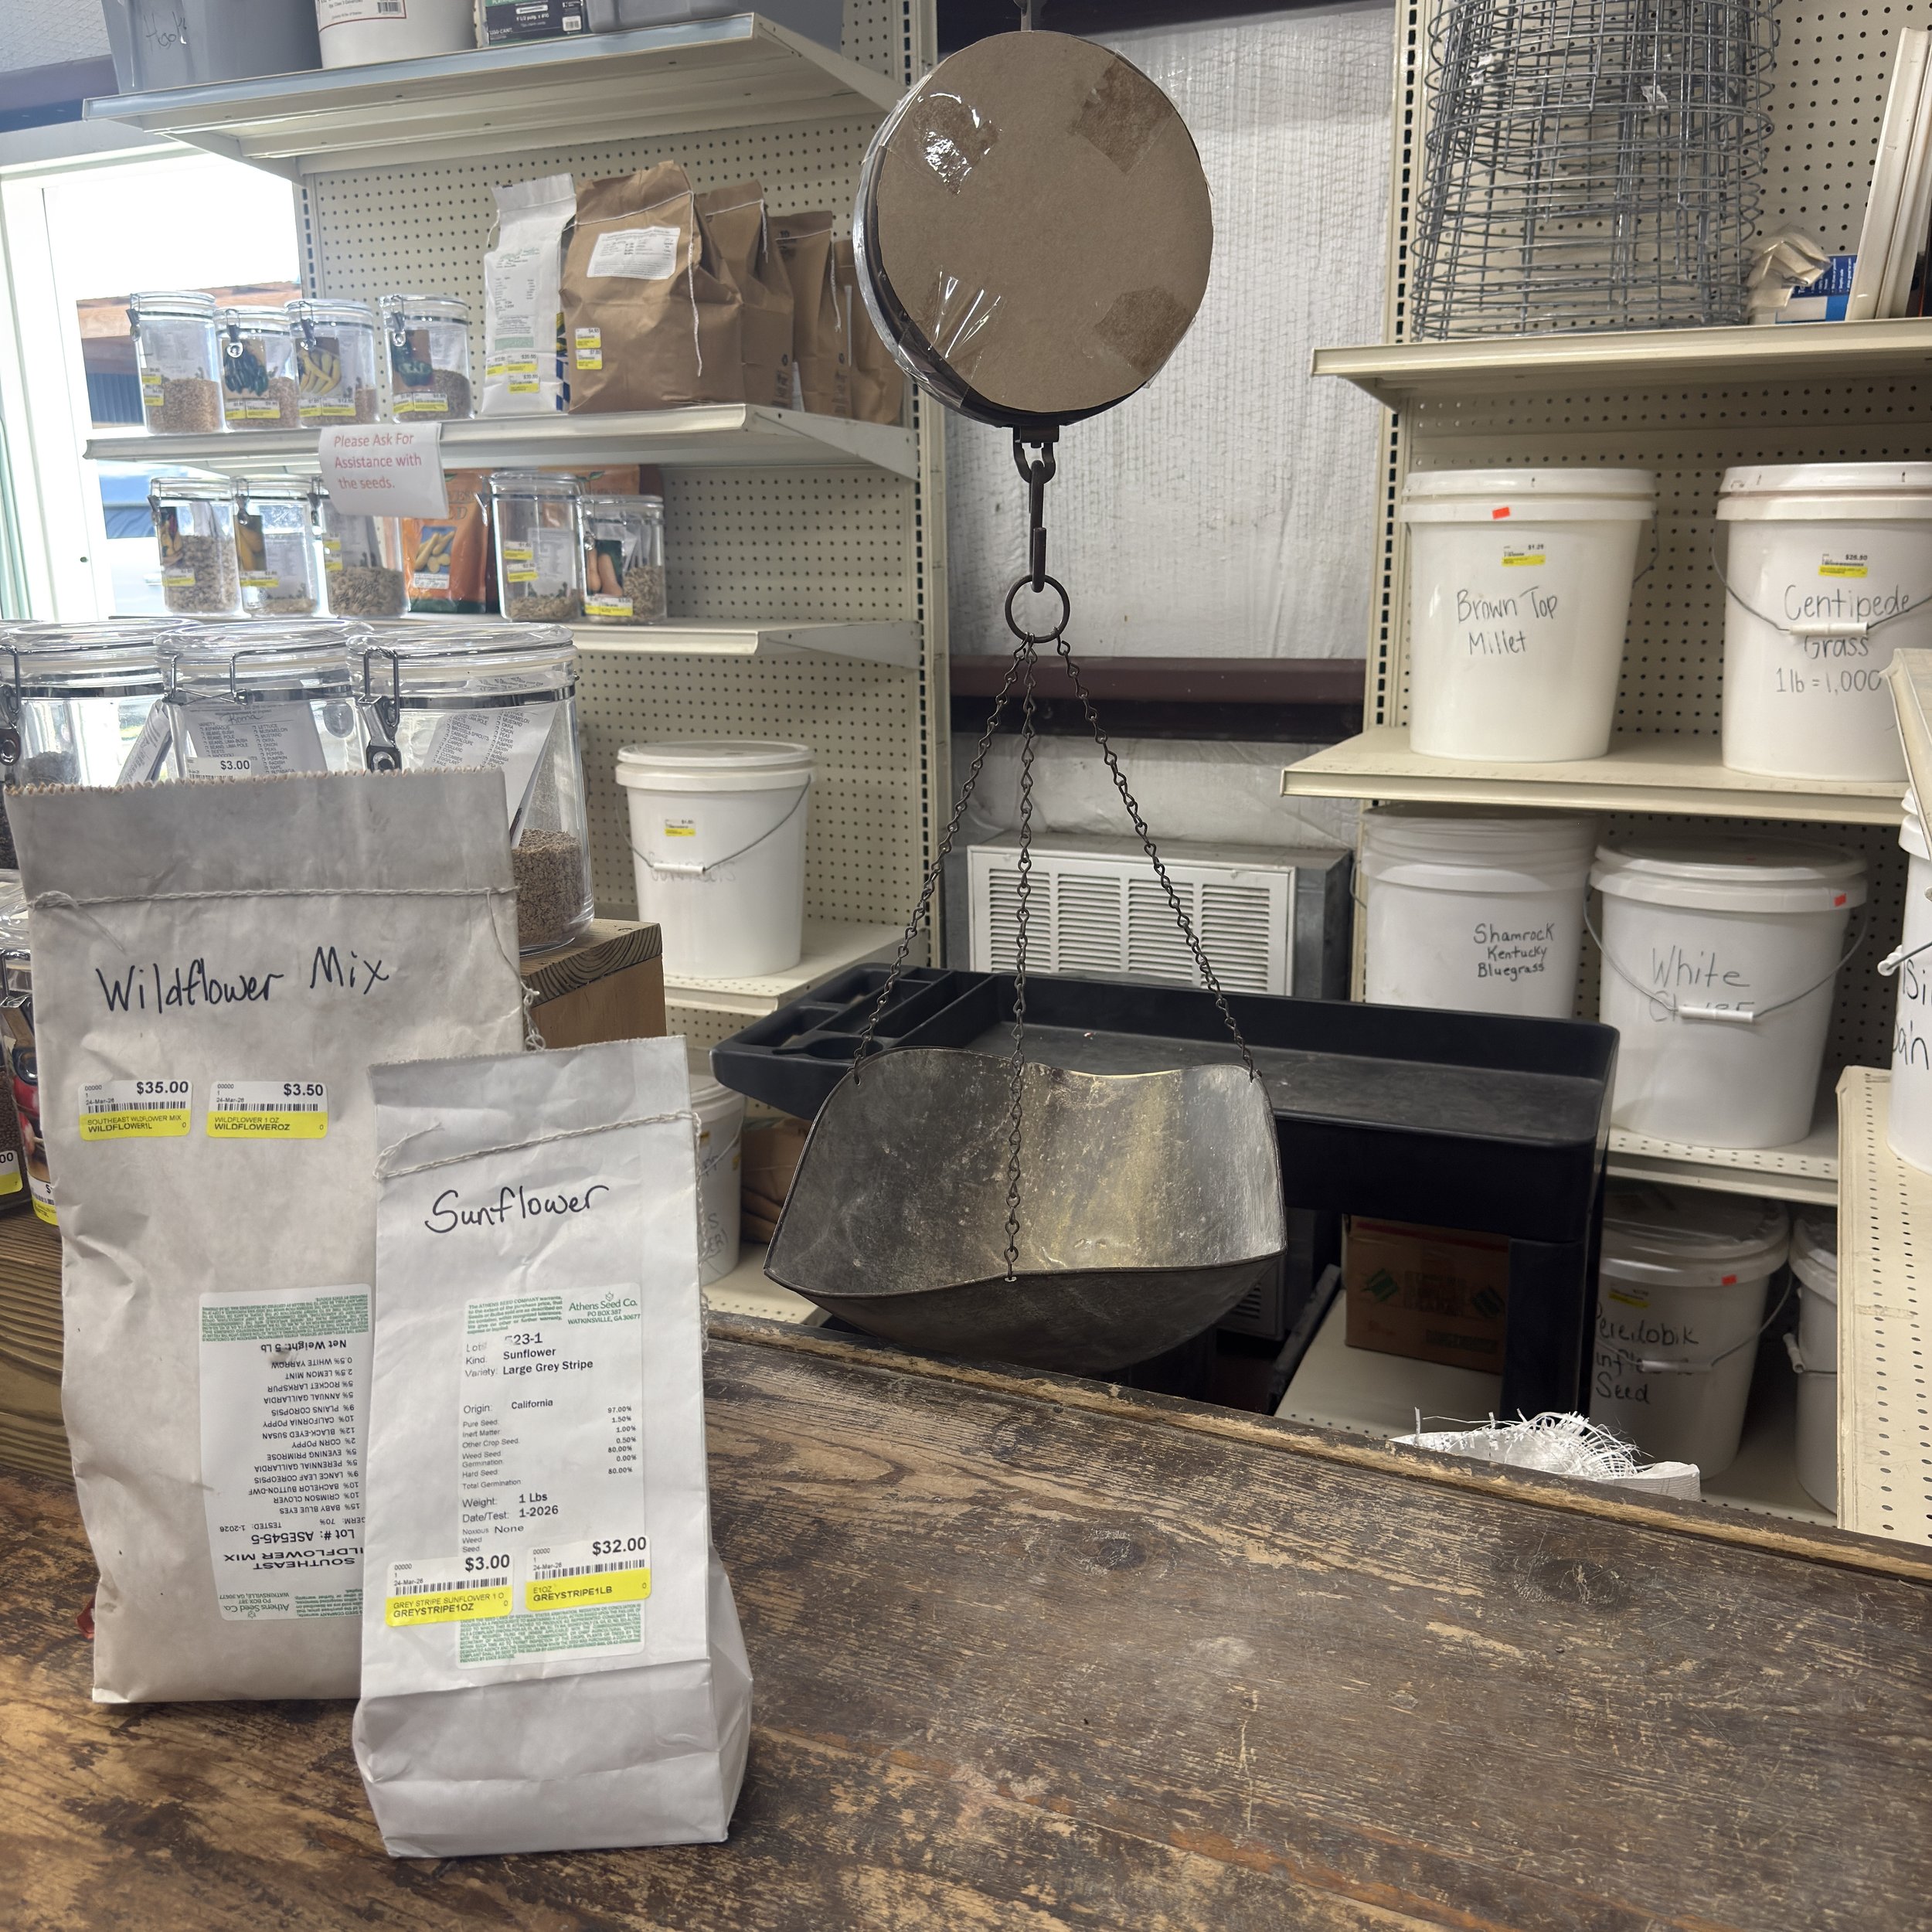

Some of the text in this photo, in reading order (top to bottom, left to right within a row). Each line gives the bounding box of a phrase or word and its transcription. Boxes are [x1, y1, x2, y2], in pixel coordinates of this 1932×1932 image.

[334, 433, 414, 447] Please Ask For
[335, 454, 422, 468] Assistance with
[338, 476, 395, 489] the seeds.
[1457, 585, 1557, 624] Brown Top
[1784, 584, 1910, 623] Centipede
[1468, 630, 1526, 655] Millet
[1804, 634, 1869, 659] Grass
[220, 760, 250, 770] $3.00
[1474, 922, 1555, 944] Shamrock
[1488, 945, 1547, 963] Kentucky
[1478, 962, 1545, 981] Bluegrass
[1653, 945, 1750, 988] White
[96, 946, 389, 1014] Wildflower Mix
[137, 1081, 189, 1095] $35.00
[284, 1083, 324, 1097] $3.50
[87, 1116, 129, 1125] SOUTHEAST
[424, 1185, 610, 1233] Sunflower
[569, 1298, 638, 1311] Athens Seed Co.
[567, 1316, 613, 1325] WATKINSVILLE,
[260, 1339, 347, 1353] Net Weight: 5 Lb
[503, 1349, 557, 1360] Sunflower
[271, 1358, 332, 1369] WHITE YARROW
[503, 1365, 532, 1376] Large
[536, 1362, 560, 1372] Grey
[562, 1360, 594, 1370] Stripe
[306, 1369, 333, 1378] LEMON
[267, 1381, 341, 1393] ROCKET LARKSPUR
[1595, 1371, 1651, 1405] Seed
[264, 1394, 309, 1404] GAILLARDIA
[271, 1406, 311, 1417] COROPSIS
[463, 1399, 553, 1415] Origin: California
[607, 1405, 632, 1413] 97.00%
[263, 1416, 335, 1428] CALIFORNIA POPPY
[463, 1420, 479, 1429] Pure
[611, 1415, 632, 1423] 1.50%
[290, 1428, 335, 1438] BLACK-EYED
[462, 1430, 478, 1438] Inert
[616, 1425, 637, 1434] 1.00%
[291, 1440, 317, 1449] POPPY
[462, 1440, 481, 1449] Other
[483, 1440, 500, 1448] Crop
[616, 1436, 637, 1444] 0.50%
[267, 1449, 342, 1461] EVENING PRIMROSE
[462, 1451, 482, 1460] Weed
[616, 1454, 637, 1462] 0.00%
[254, 1461, 343, 1473] PERENNIAL GAILLARDIA
[462, 1470, 479, 1478] Hard
[608, 1466, 633, 1475] 80.00%
[253, 1475, 298, 1485] COREOPSIS
[319, 1471, 344, 1480] LANCE
[248, 1483, 339, 1495] BACHELOR BUTTON-DWF
[462, 1482, 479, 1491] Total
[304, 1493, 340, 1502] CRIMSON
[519, 1493, 526, 1503] 1
[529, 1492, 548, 1503] Lbs
[519, 1505, 559, 1518] 1-2026
[252, 1522, 282, 1530] TESTED:
[462, 1525, 525, 1536] Noxious None
[251, 1531, 314, 1545] ASE545-5
[335, 1529, 355, 1539] Lot
[593, 1536, 647, 1556] $32.00
[223, 1547, 364, 1562] ILDFLOWER MIX
[253, 1557, 355, 1570] SOUTHEAST
[464, 1554, 510, 1573] $3.00
[533, 1586, 613, 1602] GREYSTRIPE1LB
[393, 1601, 414, 1610] GREY
[416, 1597, 441, 1607] STRIPE
[443, 1593, 491, 1604] SUNFLOWER
[393, 1603, 474, 1618] GREYSTRIPE1OZ
